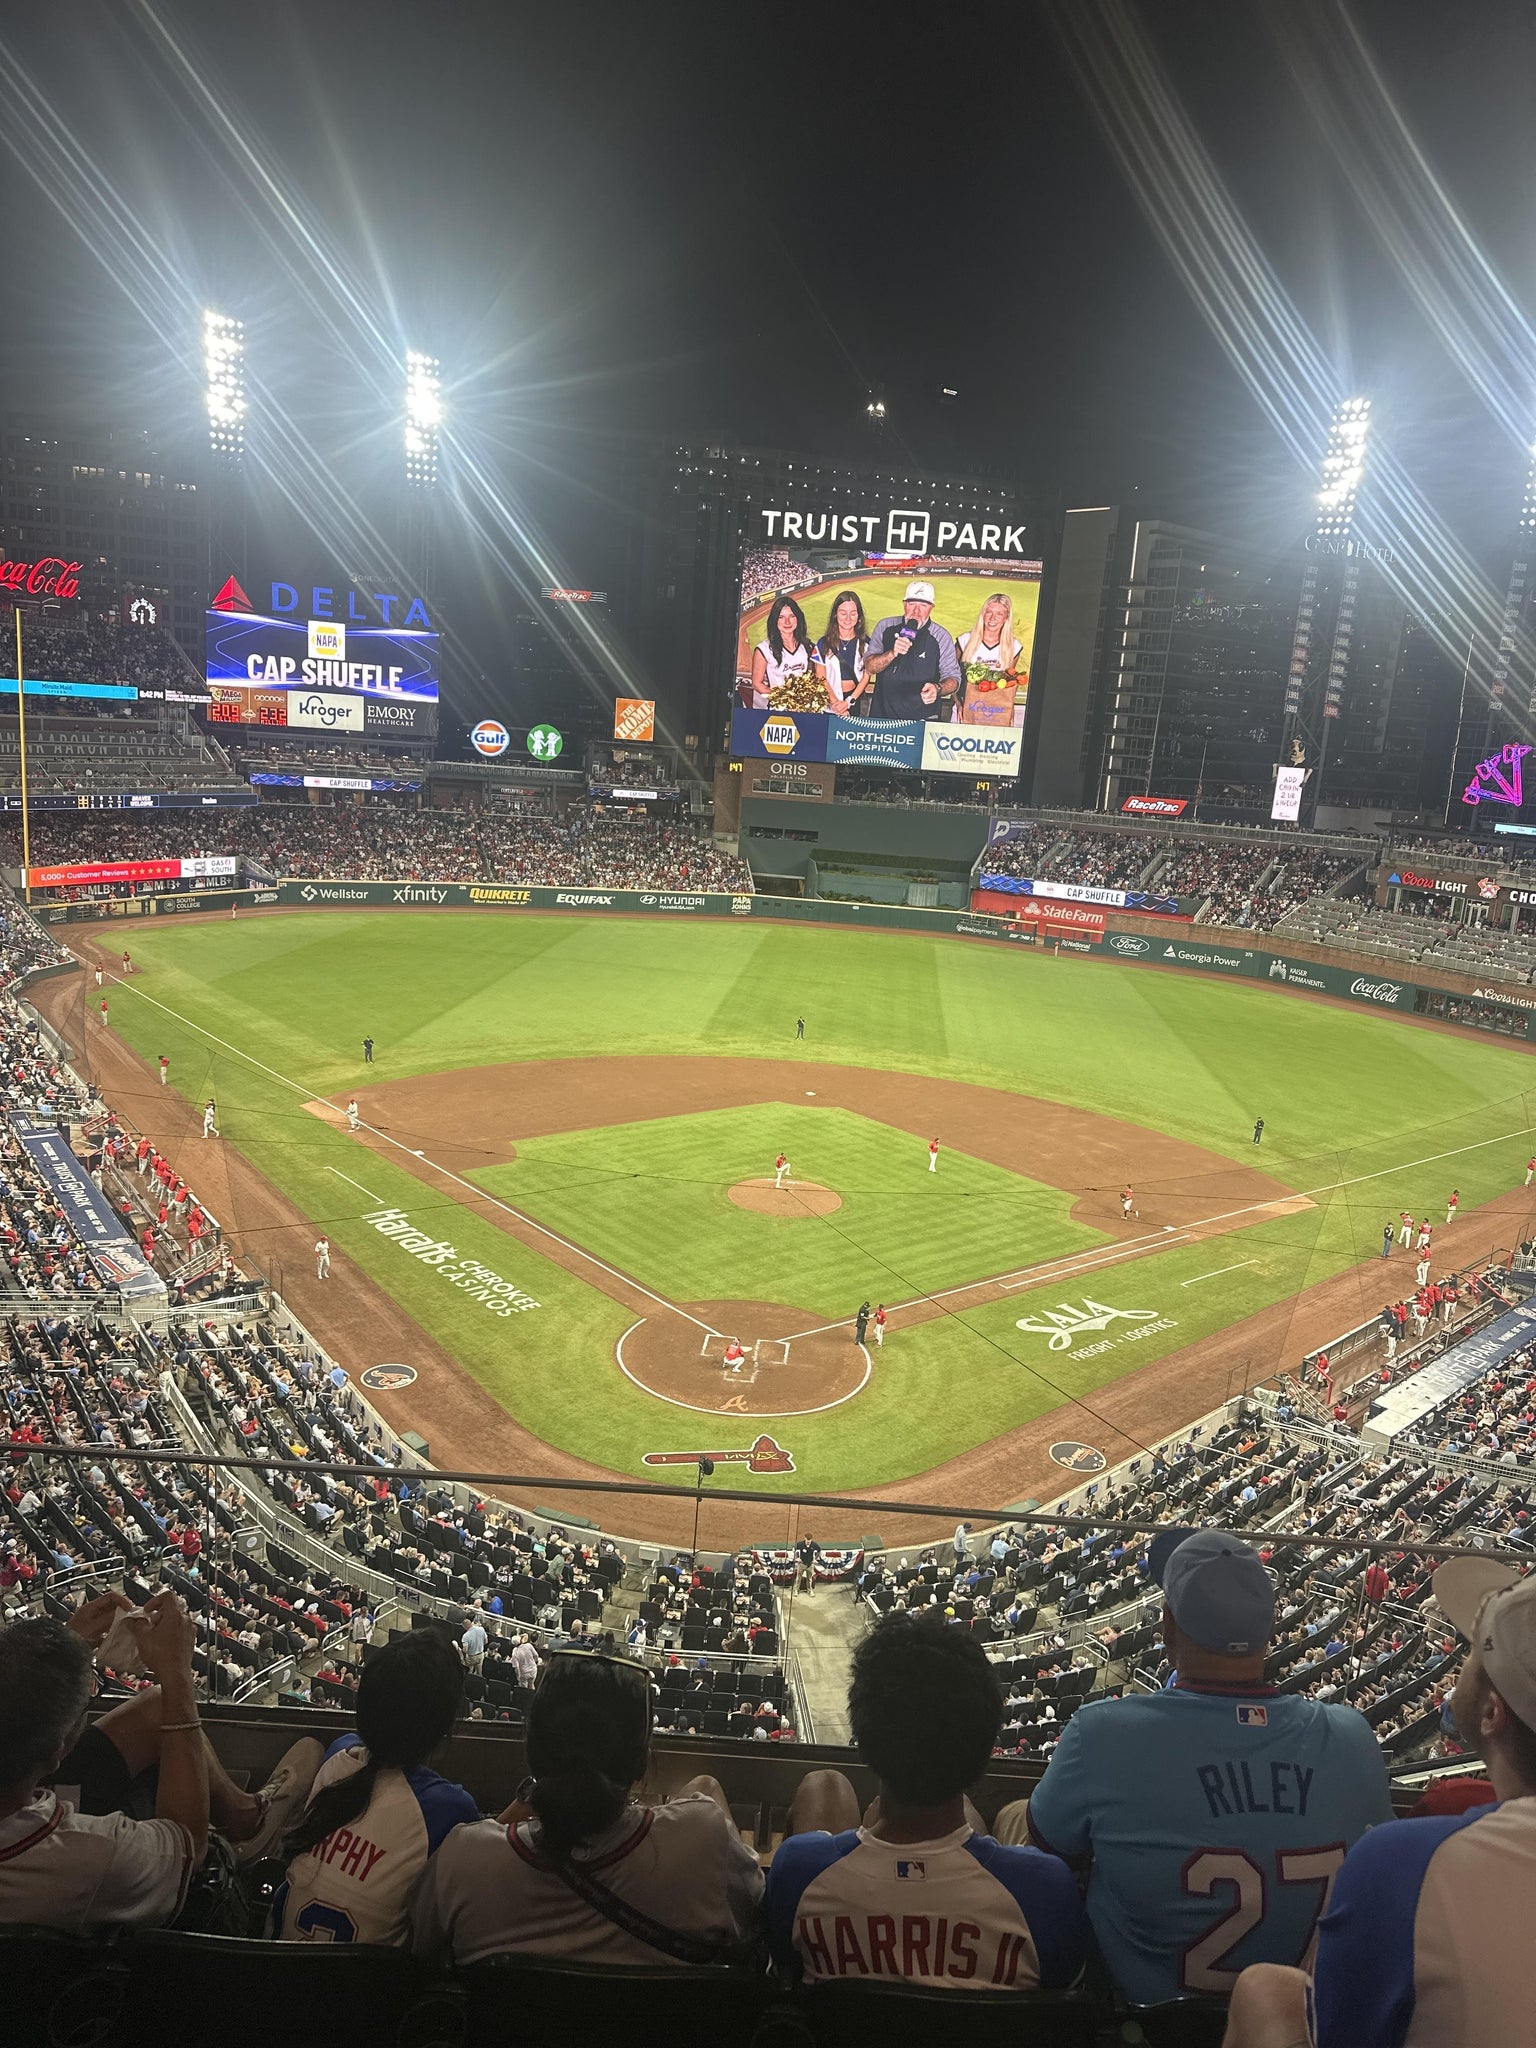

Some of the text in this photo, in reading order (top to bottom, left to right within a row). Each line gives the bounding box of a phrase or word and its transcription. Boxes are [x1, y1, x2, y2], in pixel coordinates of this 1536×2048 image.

[762, 510, 1027, 553] TRUIST PARK
[0, 557, 83, 599] ca-Cola
[271, 582, 431, 627] DELTA
[316, 634, 338, 649] NAPA
[247, 653, 403, 692] CAP SHUFFLE
[212, 704, 240, 717] 209
[260, 707, 287, 720] 232
[299, 696, 352, 726] Kroger
[367, 706, 416, 720] EMORY
[620, 704, 637, 719] THE
[367, 718, 415, 727] HEALTHCARE
[616, 701, 654, 738] HOME
[630, 715, 654, 739] DEPOT
[474, 731, 506, 745] Gulf
[766, 726, 794, 744] NAPA
[835, 731, 915, 745] NORTHSIDE
[849, 743, 900, 754] HOSPITAL
[936, 736, 1016, 754] COOLRAY
[770, 763, 807, 776] ORIS
[329, 779, 369, 788] CAP SHUFFLE
[1127, 799, 1179, 812] RaceTrac
[41, 869, 129, 881] 5,000+ Customer Reviews
[206, 877, 232, 887] MLB+
[1402, 871, 1468, 894] Coors LIGHT
[88, 884, 116, 896] MLB+
[154, 880, 181, 890] MB+
[319, 888, 369, 899] Wellstar
[393, 885, 448, 904] xfinity
[469, 887, 532, 901] QUIKRETE
[556, 893, 613, 906] EQUIFAX
[659, 896, 705, 906] HYUNDAI
[733, 896, 751, 904] PAPA
[1067, 887, 1121, 904] CAP SHUFFLE
[1510, 890, 1536, 905] CHO
[732, 903, 752, 911] JOHNS
[1068, 941, 1091, 950] National
[1116, 936, 1143, 951] Ford
[1178, 950, 1241, 968] Georgia Power
[1289, 968, 1308, 977] KAISER
[1288, 976, 1324, 988] PERMANENTE
[1484, 988, 1511, 1004] Coors
[436, 1264, 520, 1317] CASINOS
[459, 1260, 542, 1312] CHEROKEE
[1066, 1318, 1180, 1362] FREIGHT LOGISTICS
[1471, 1340, 1505, 1360] PARK
[1196, 1761, 1315, 1819] RILEY
[310, 1828, 387, 1883] RPHY
[1179, 1840, 1348, 1992] 27
[800, 1915, 1027, 1986] HARRIS II
